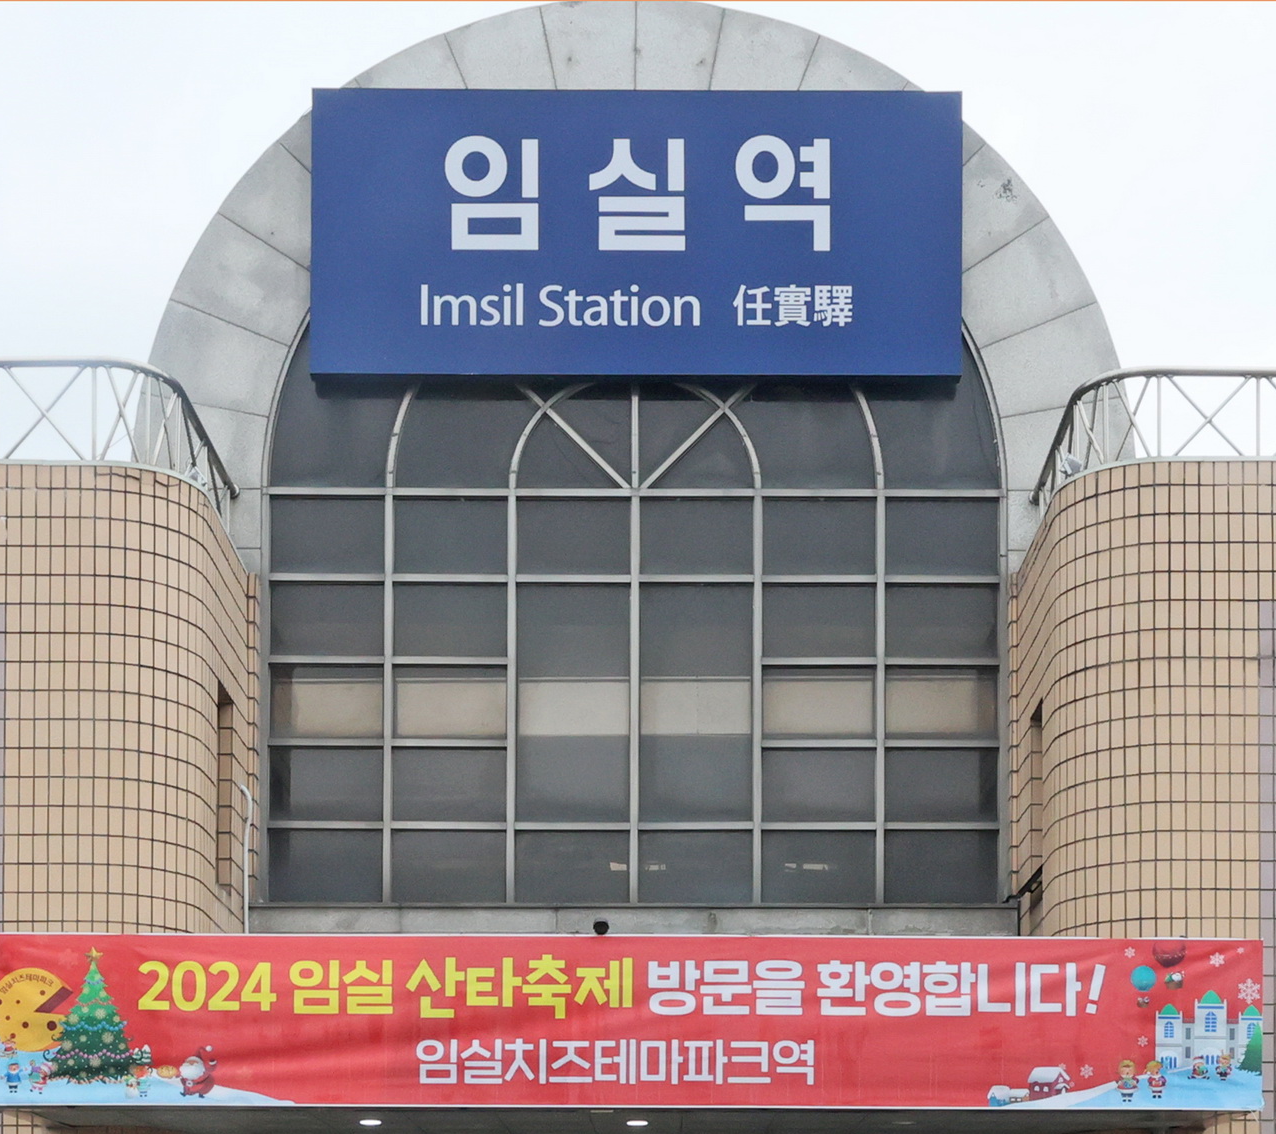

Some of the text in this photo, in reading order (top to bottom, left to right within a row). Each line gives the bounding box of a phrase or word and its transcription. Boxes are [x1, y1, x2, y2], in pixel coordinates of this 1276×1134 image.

[443, 134, 831, 252] 임실역
[420, 283, 701, 327] Imsil Station
[732, 283, 854, 327] 任實驛
[137, 954, 1106, 1019] 2024 임실 산타축제 방문을 환영합니다!
[416, 1039, 815, 1085] 임실치즈테마파크역
